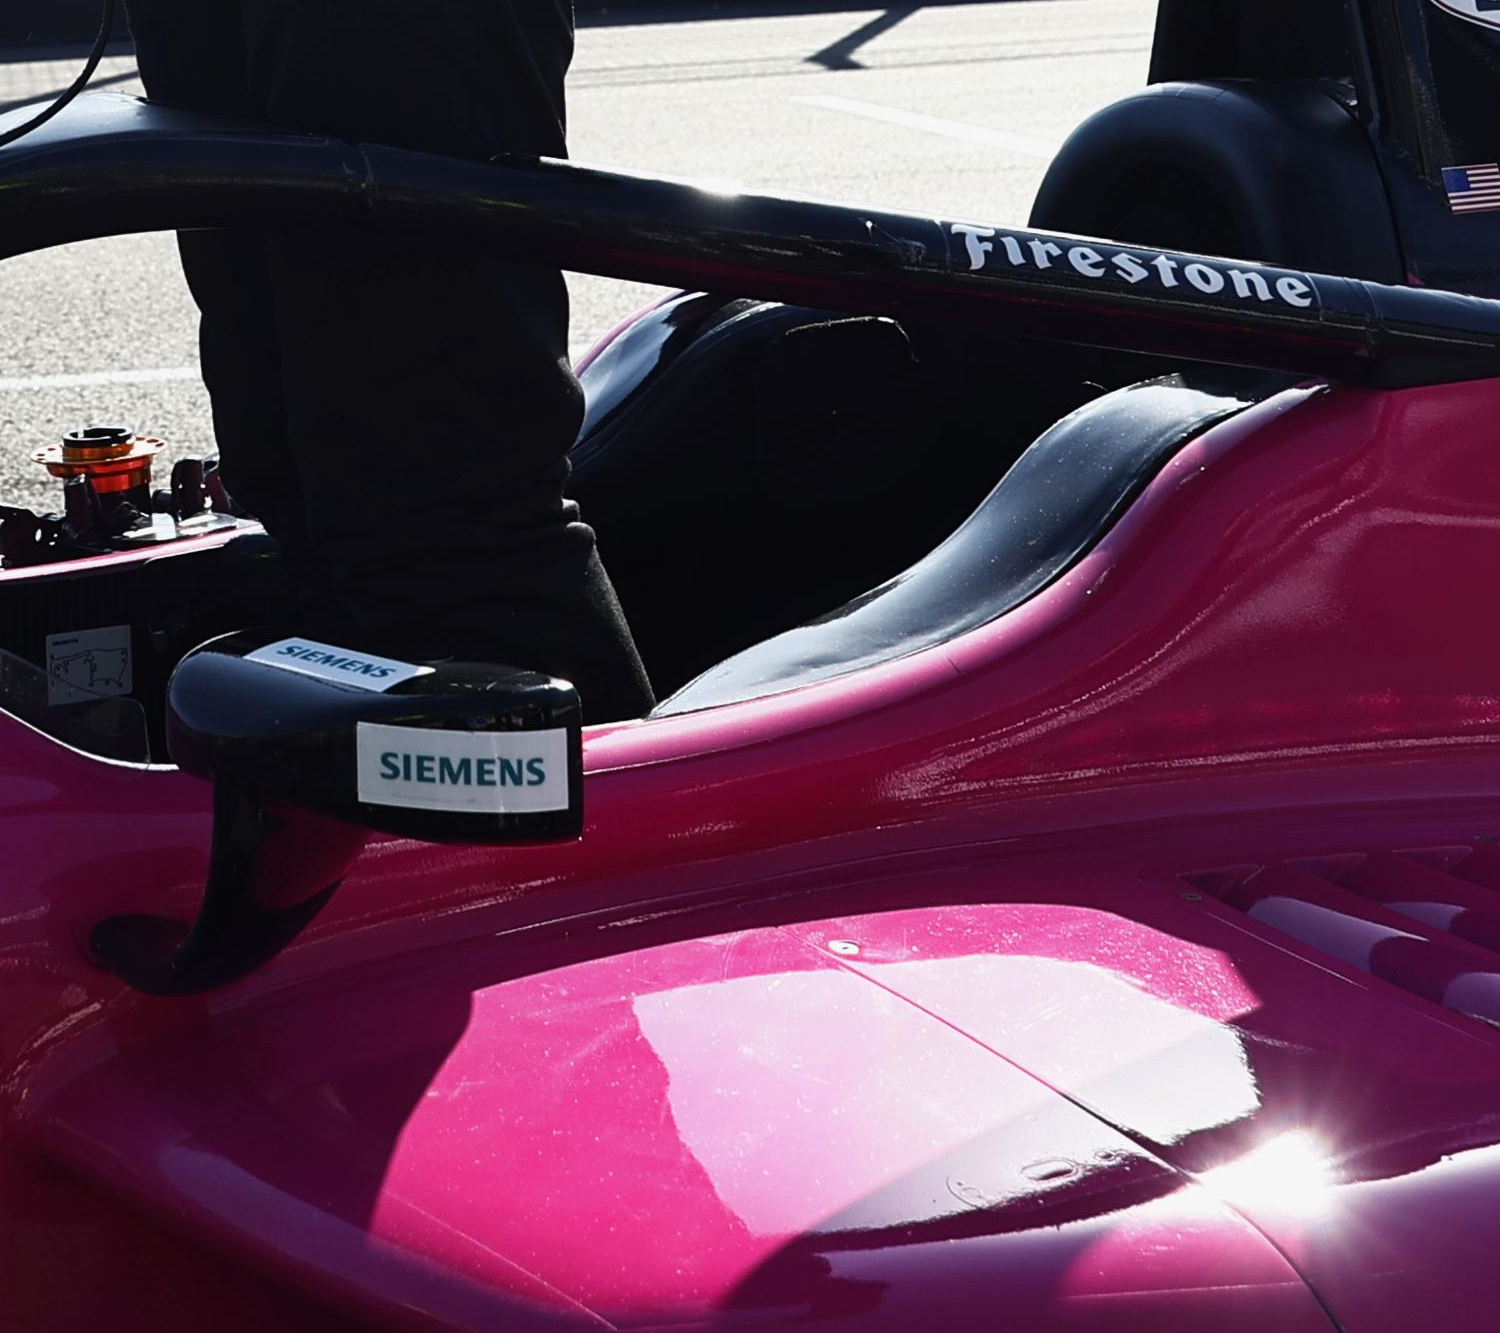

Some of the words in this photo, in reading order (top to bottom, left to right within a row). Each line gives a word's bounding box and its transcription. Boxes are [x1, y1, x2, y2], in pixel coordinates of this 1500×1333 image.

[950, 222, 1315, 309] Firestone
[275, 644, 399, 680] SIEMENS
[379, 750, 547, 788] SIEMENS
